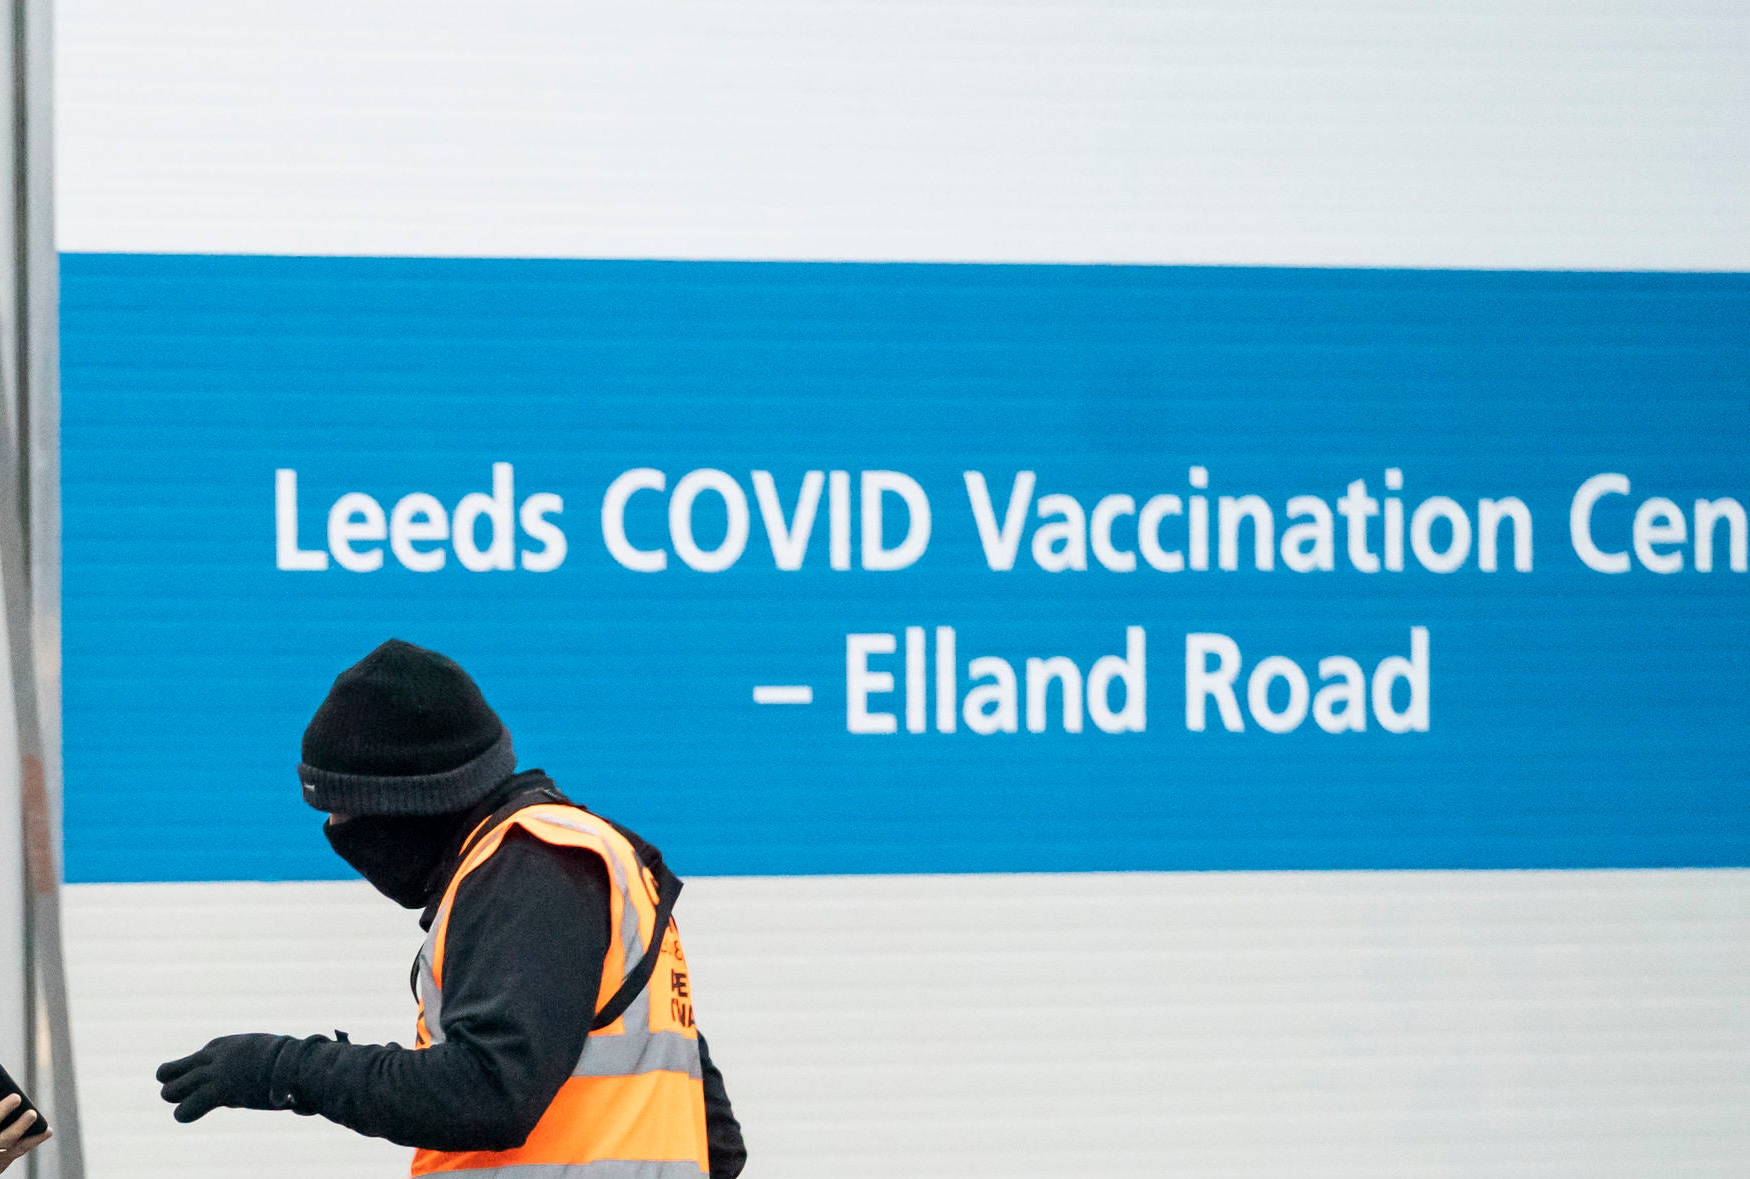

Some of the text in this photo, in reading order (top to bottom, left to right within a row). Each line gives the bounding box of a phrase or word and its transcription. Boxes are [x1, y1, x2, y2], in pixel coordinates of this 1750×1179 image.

[275, 462, 568, 573] Leeds
[601, 468, 932, 573] COVID
[963, 466, 1533, 573] Vaccination
[845, 626, 1146, 735] Elland
[1185, 627, 1430, 733] Road
